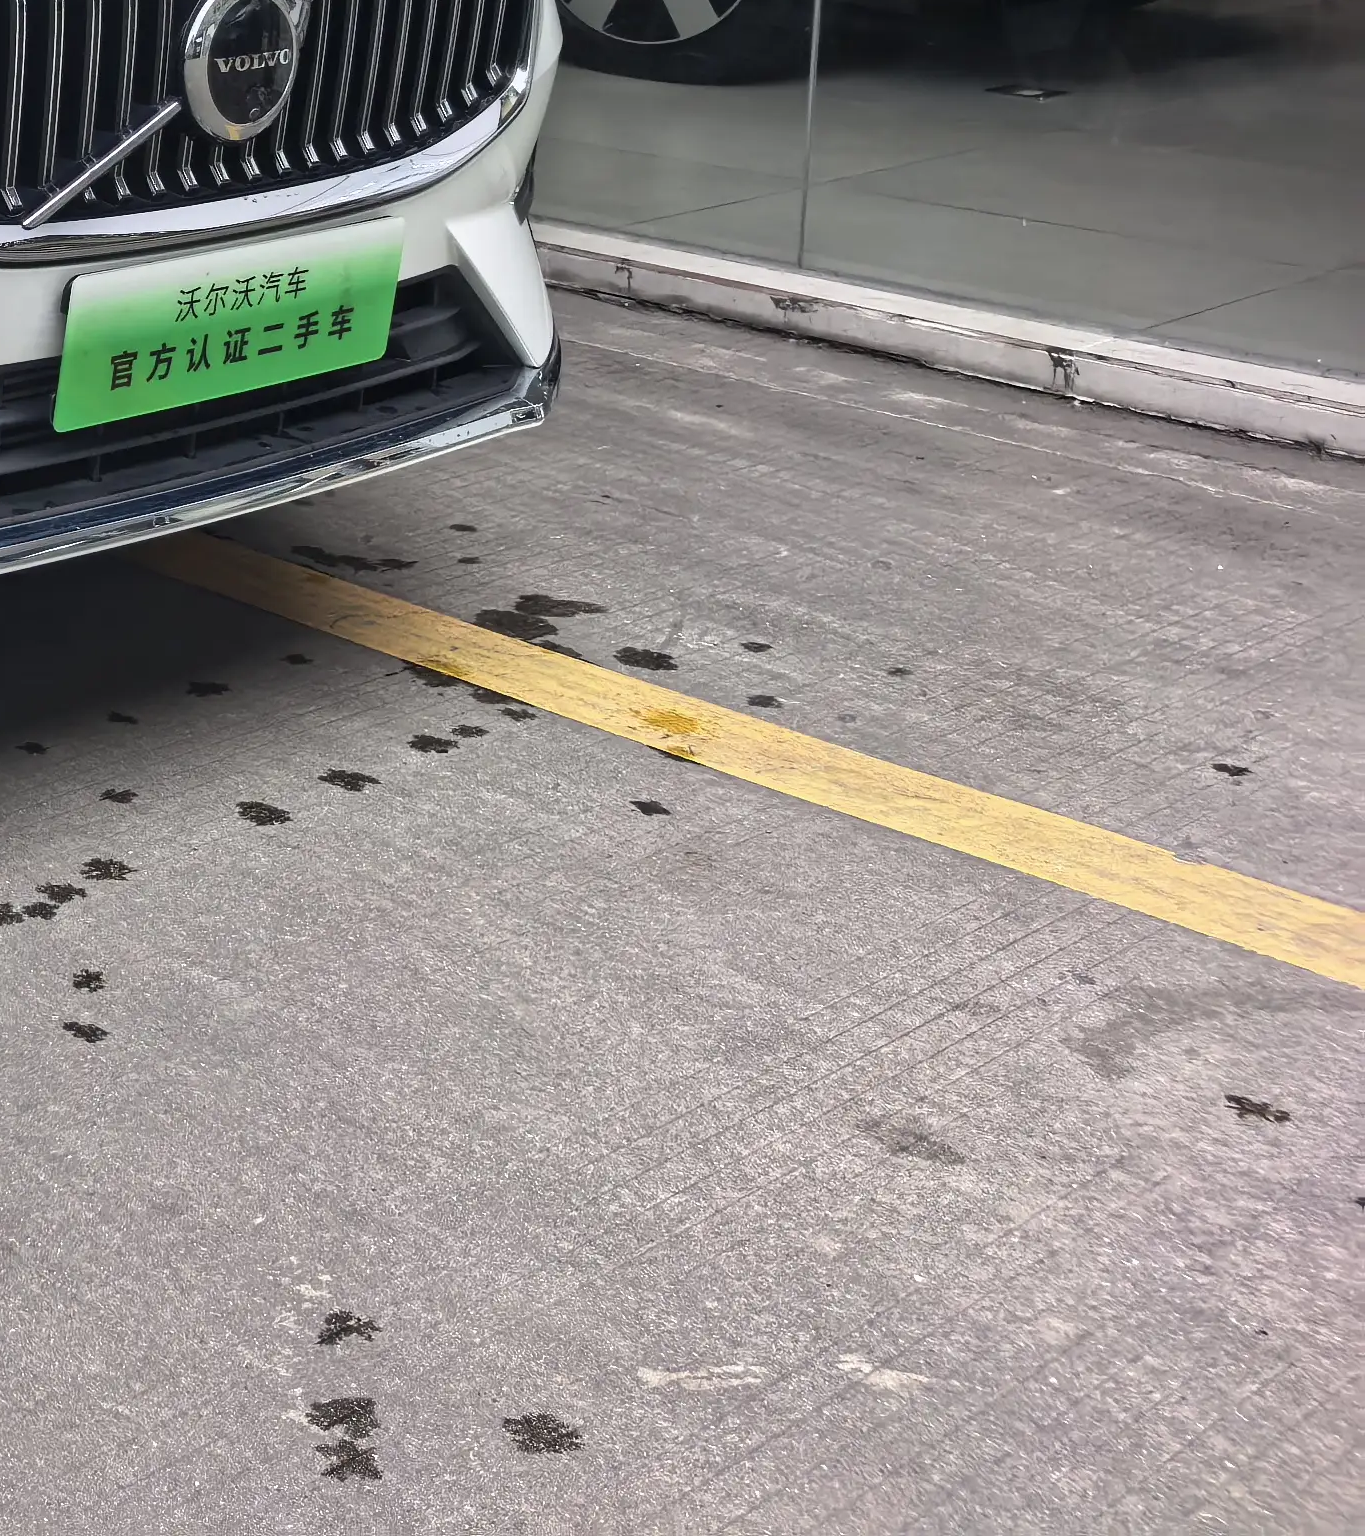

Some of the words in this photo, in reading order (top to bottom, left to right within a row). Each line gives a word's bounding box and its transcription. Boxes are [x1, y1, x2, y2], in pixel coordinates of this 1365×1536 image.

[214, 48, 290, 73] VOLVO
[175, 266, 310, 322] 沃尔沃汽车
[110, 305, 355, 391] 官方认证二手车
